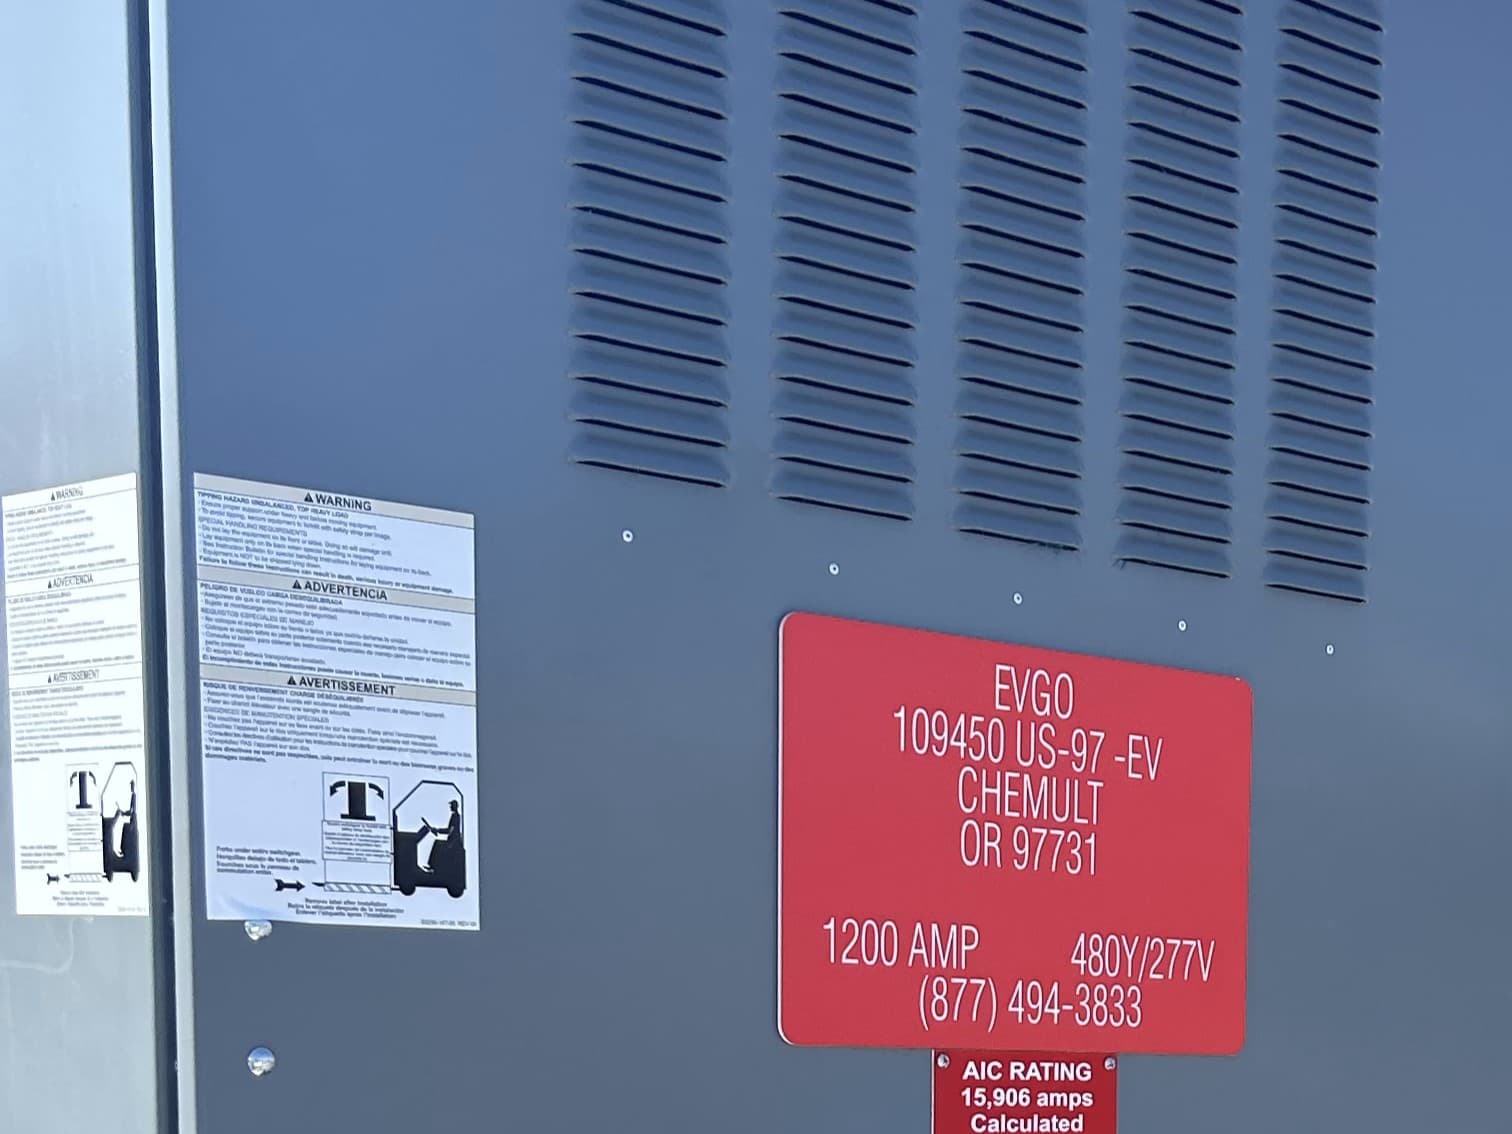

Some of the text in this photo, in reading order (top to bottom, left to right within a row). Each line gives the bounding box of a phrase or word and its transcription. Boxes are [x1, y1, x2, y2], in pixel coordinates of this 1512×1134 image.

[55, 485, 84, 500] WARNING
[314, 493, 372, 512] WARNING
[304, 579, 388, 601] ADVERTENCIA
[298, 676, 396, 696] AVERTISSEMENT
[994, 664, 1074, 719] EVGO
[894, 705, 1164, 781] 109450 US-97 -EV
[958, 765, 1104, 825] CHEMULT
[959, 820, 1097, 875] OR 97731
[823, 917, 980, 969] 1200 AMP
[1070, 933, 1215, 982] 480Y/277V
[918, 977, 1142, 1032] (877) 494-3833
[962, 1060, 1092, 1082] AIC RATING
[961, 1088, 1094, 1112] 15,906 amps
[970, 1113, 1084, 1134] Calculated
